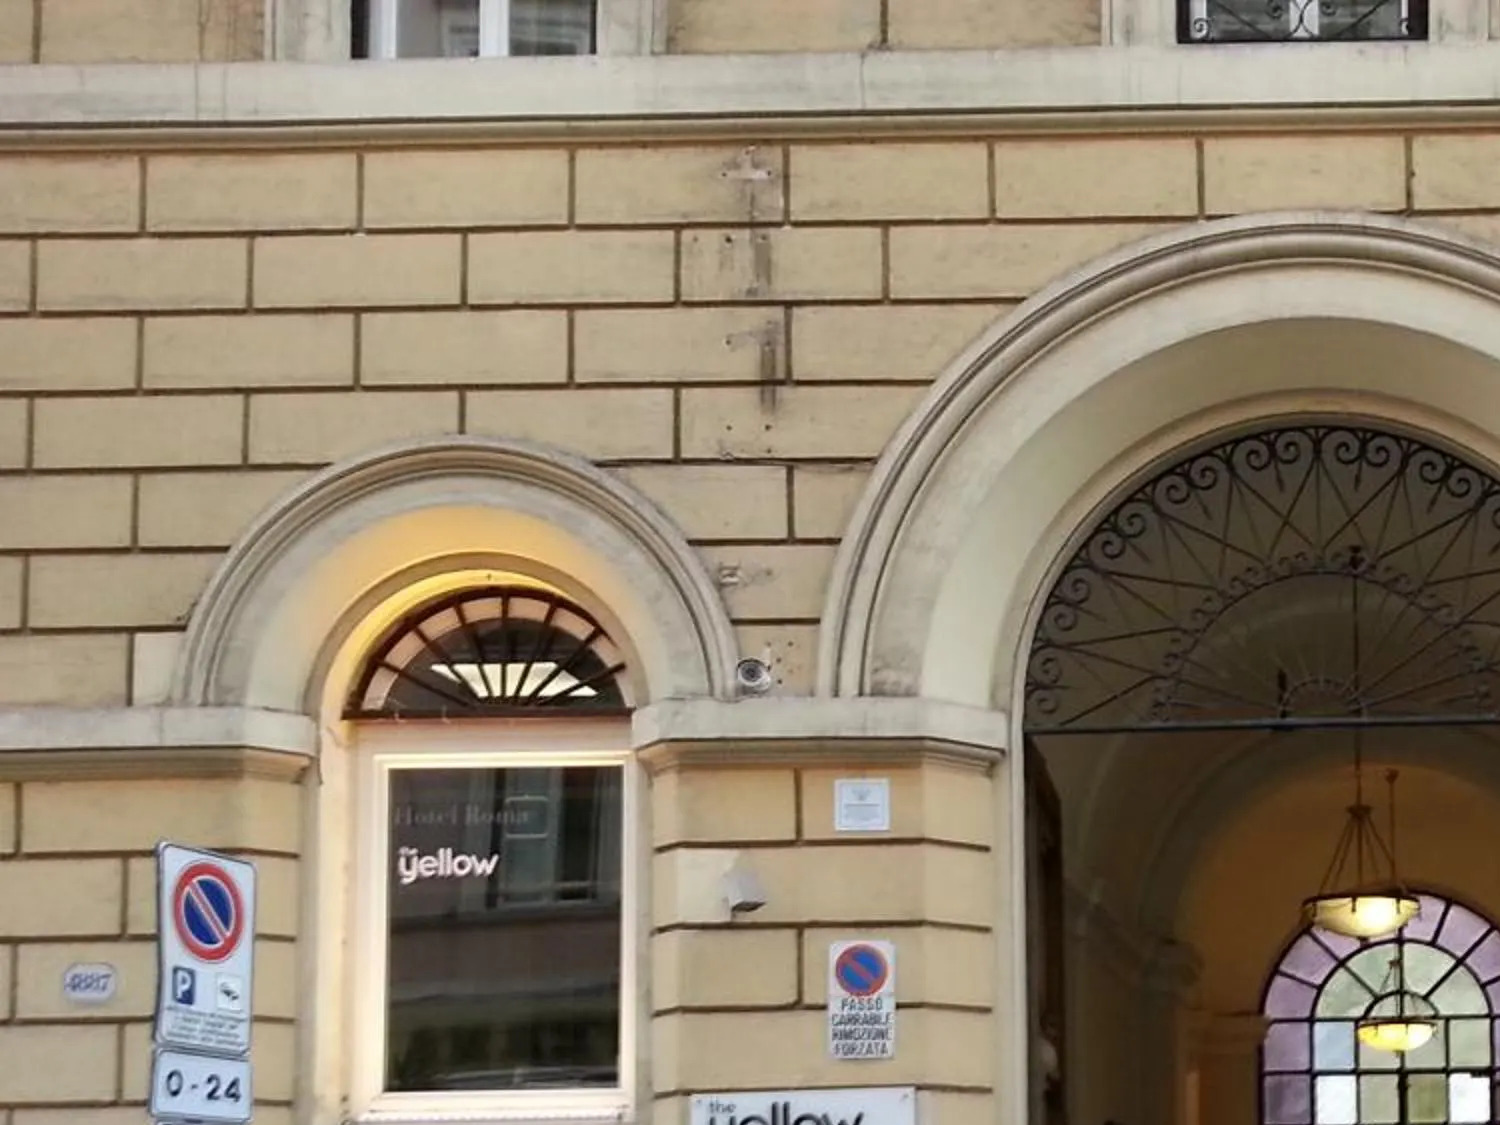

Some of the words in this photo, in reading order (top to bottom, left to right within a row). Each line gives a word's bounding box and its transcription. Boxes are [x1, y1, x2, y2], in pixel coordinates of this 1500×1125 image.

[399, 848, 499, 884] yellow
[841, 997, 883, 1010] PASSO
[832, 1012, 893, 1026] CARRABILE
[206, 1074, 242, 1103] 24
[709, 1098, 737, 1114] the
